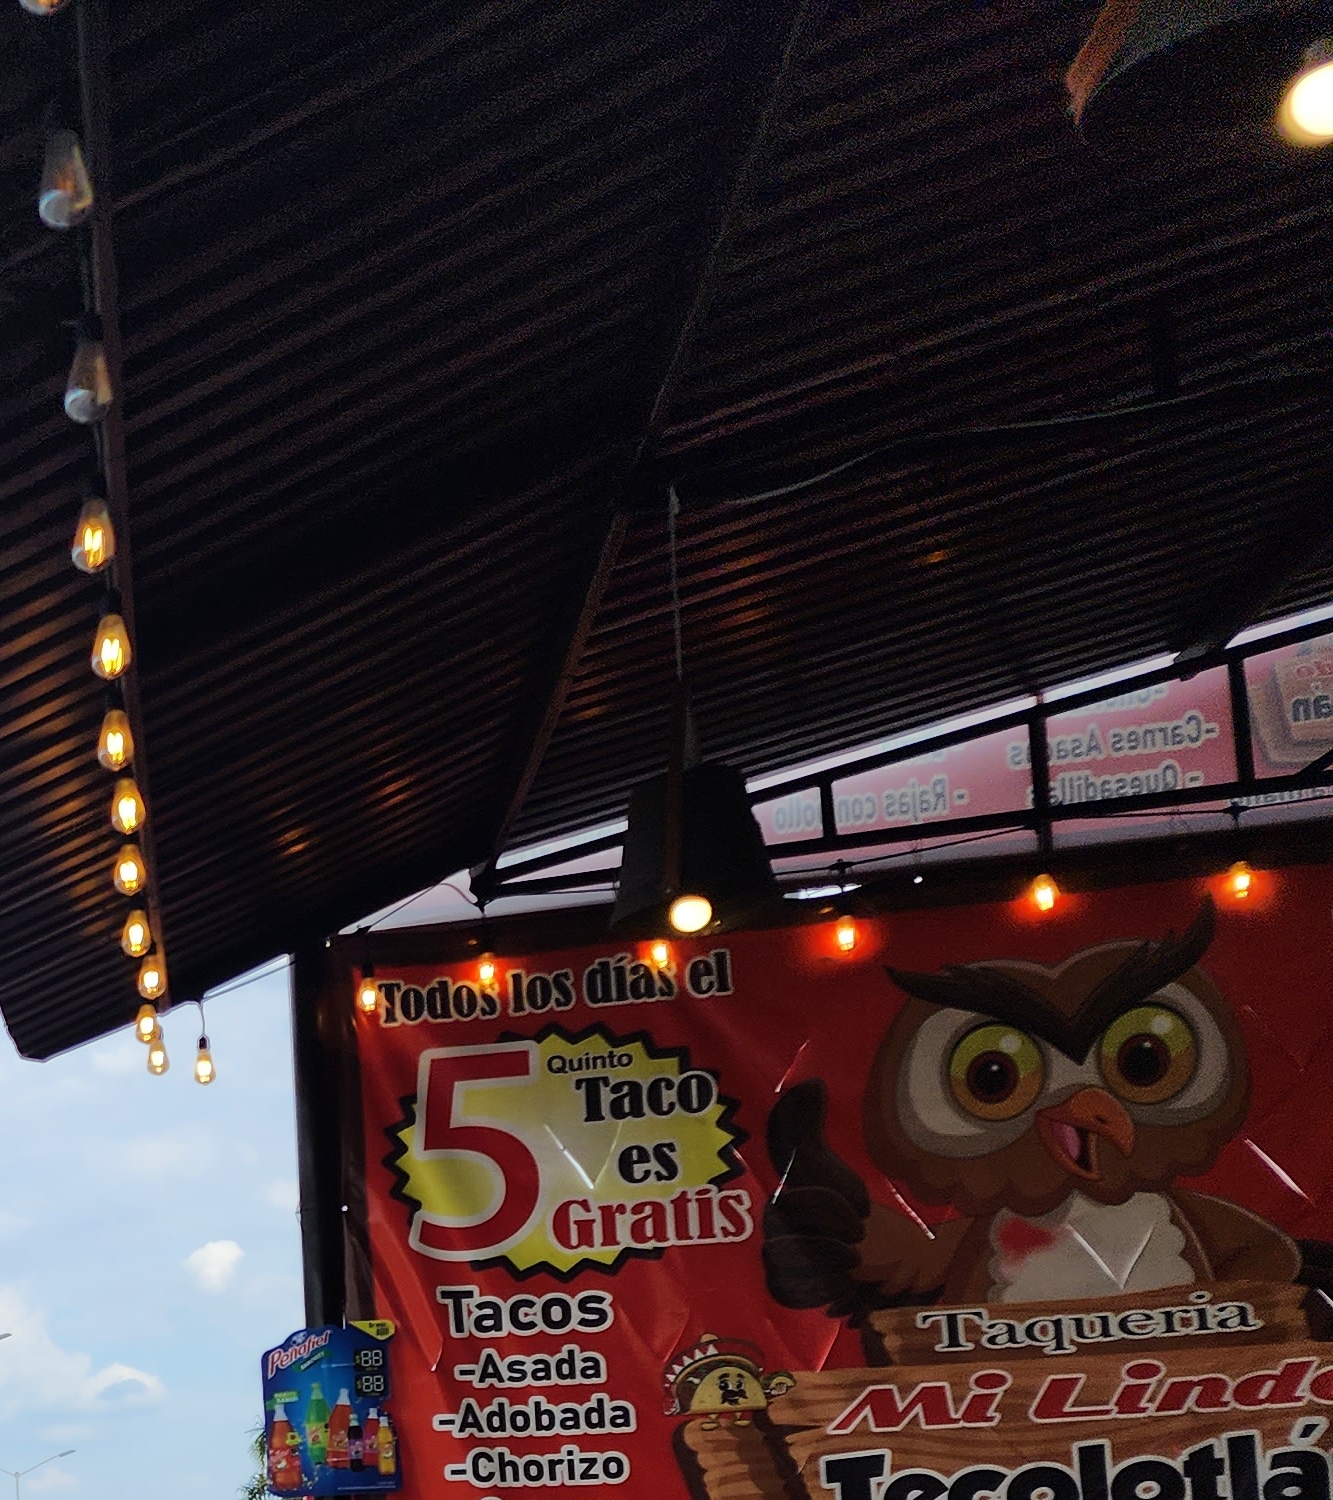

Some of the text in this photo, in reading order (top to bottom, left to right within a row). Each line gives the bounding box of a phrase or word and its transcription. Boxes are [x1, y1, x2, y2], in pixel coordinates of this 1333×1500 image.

[378, 950, 731, 1024] Todos los días el
[546, 1049, 633, 1075] Quinto
[576, 1073, 717, 1122] Taco
[412, 1042, 541, 1259] 5
[618, 1139, 678, 1184] es
[550, 1188, 754, 1250] Gratis
[439, 1288, 612, 1336] Tacos
[833, 1371, 1010, 1432] Mi
